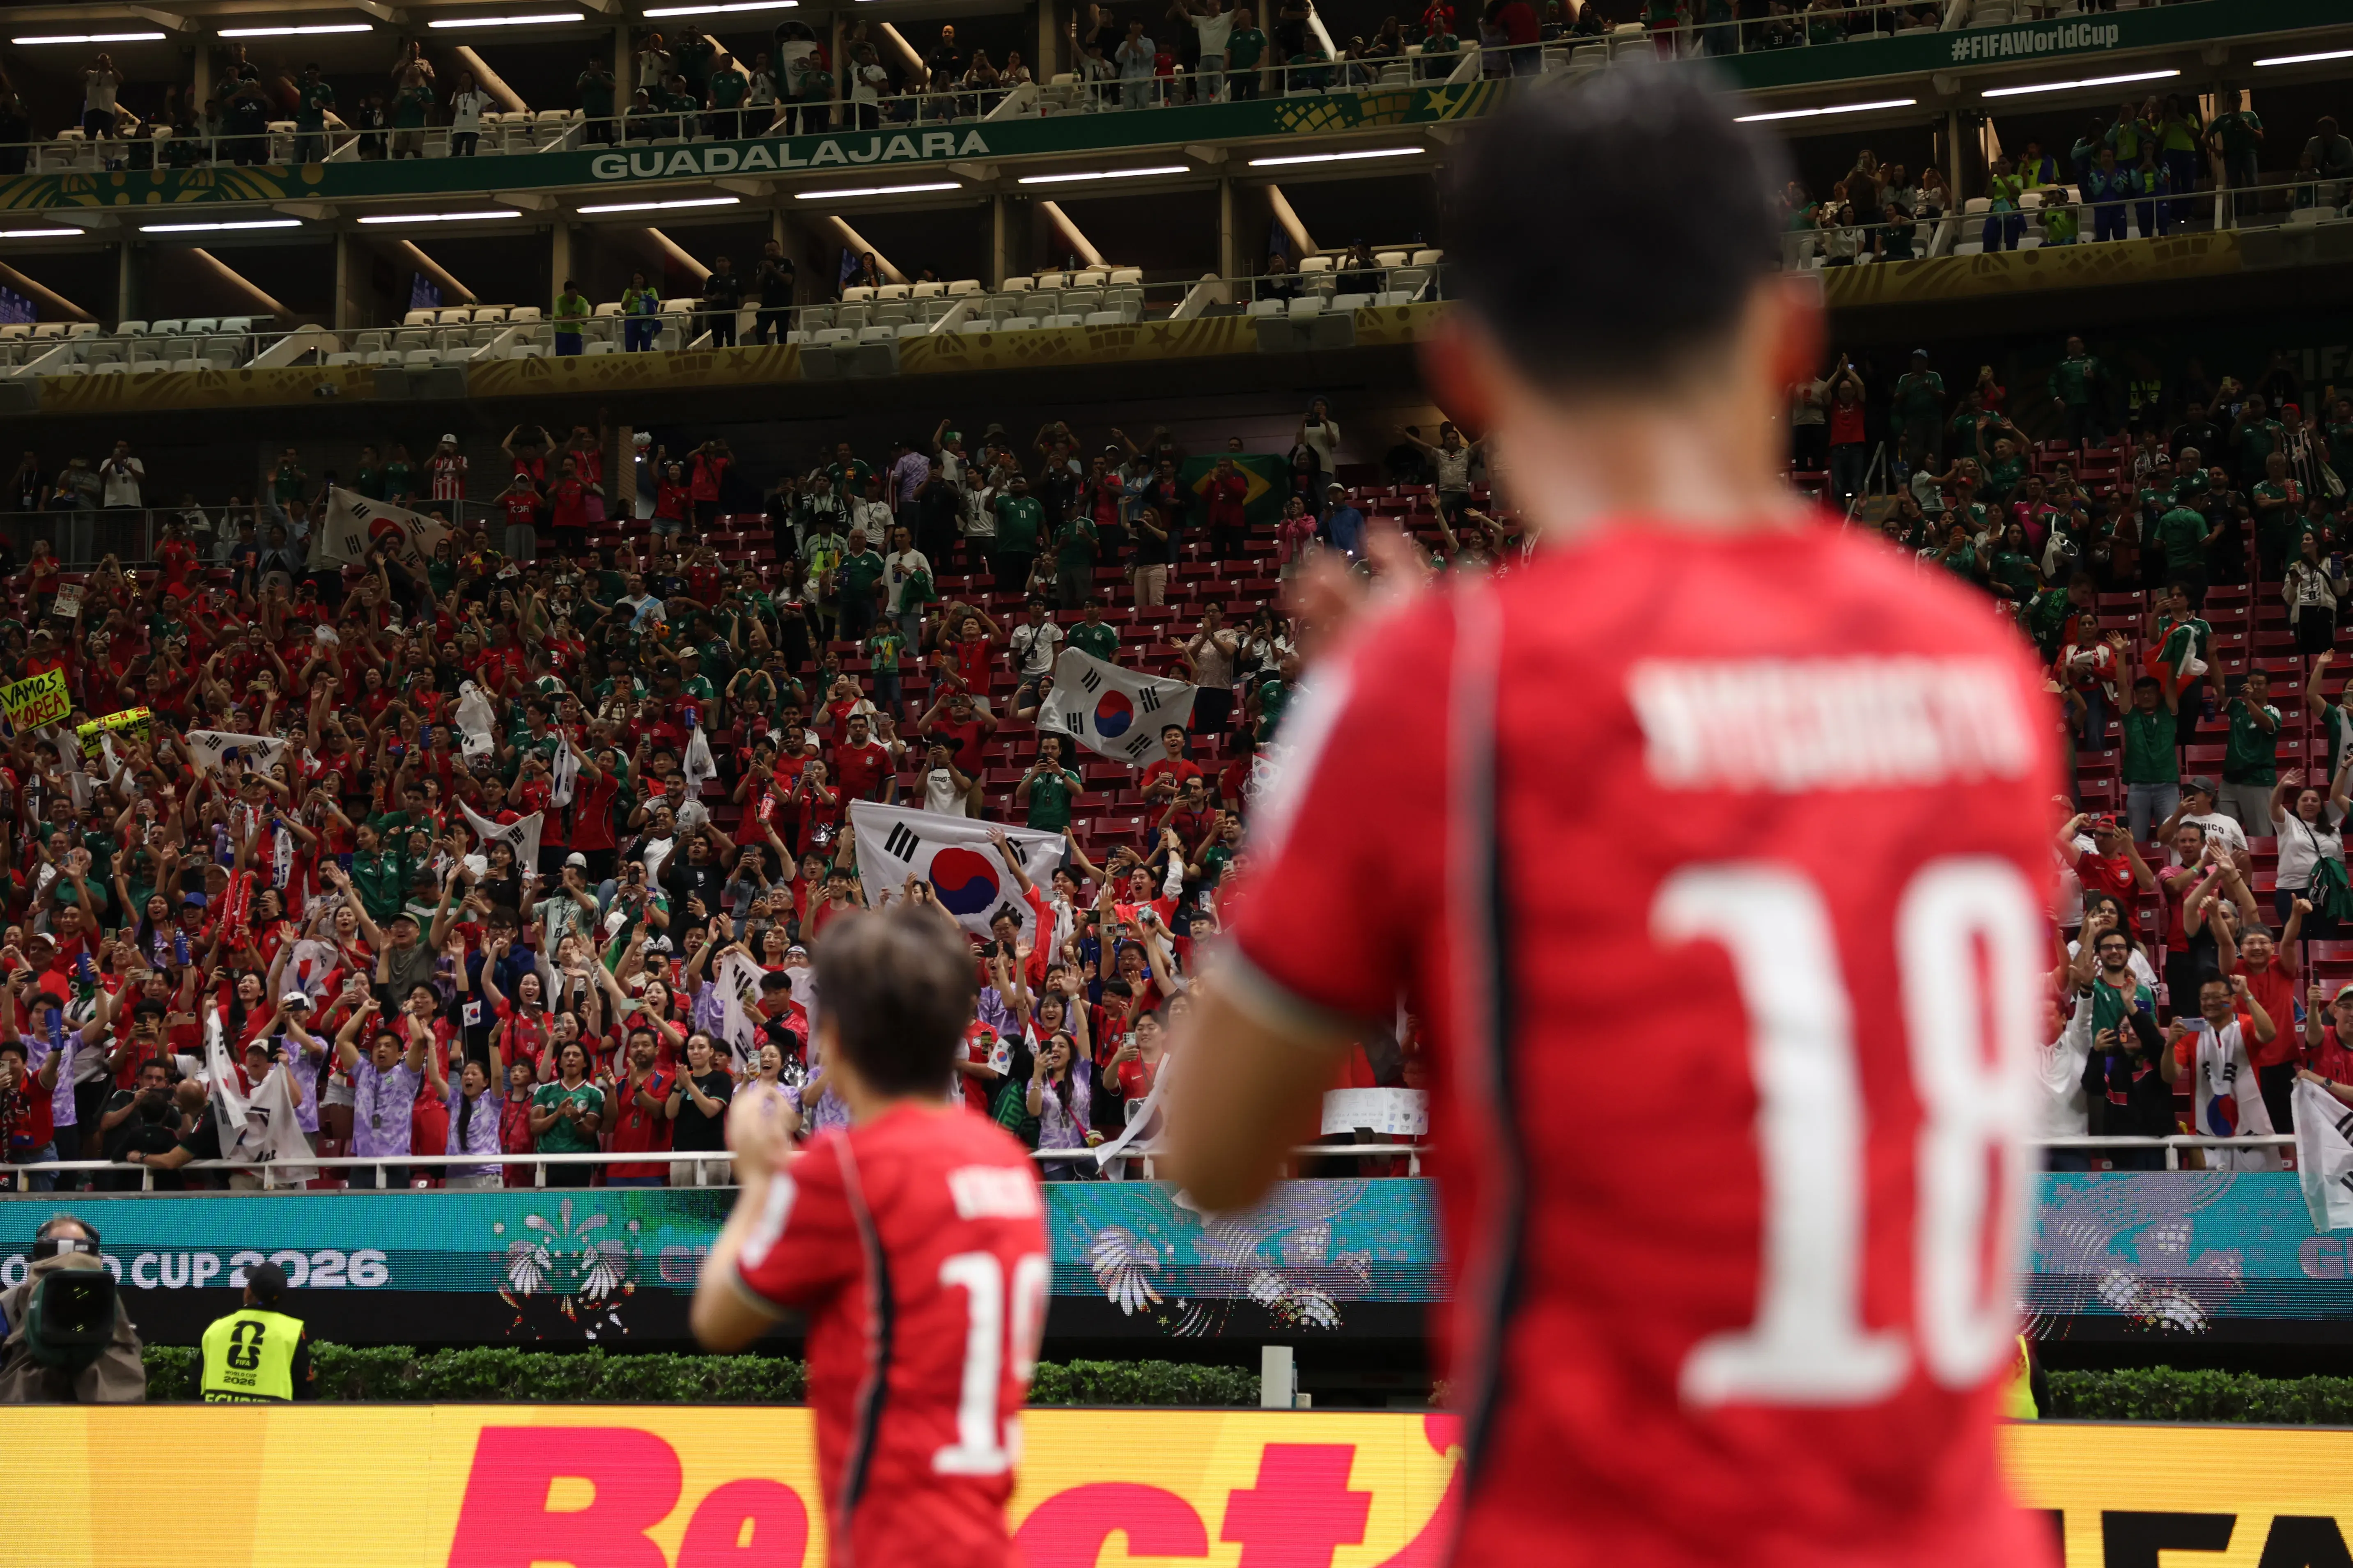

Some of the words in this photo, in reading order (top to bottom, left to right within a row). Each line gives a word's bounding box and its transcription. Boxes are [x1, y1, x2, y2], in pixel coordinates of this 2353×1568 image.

[1951, 23, 2119, 61] #FIFAWorldCup
[591, 130, 990, 179] GUADALAJARA
[0, 671, 57, 708] VAMOS
[10, 692, 67, 732] KOREA
[1645, 853, 2047, 1409] 18
[131, 1251, 221, 1289] CUP
[230, 1249, 390, 1289] 2026
[223, 1376, 256, 1387] 2026
